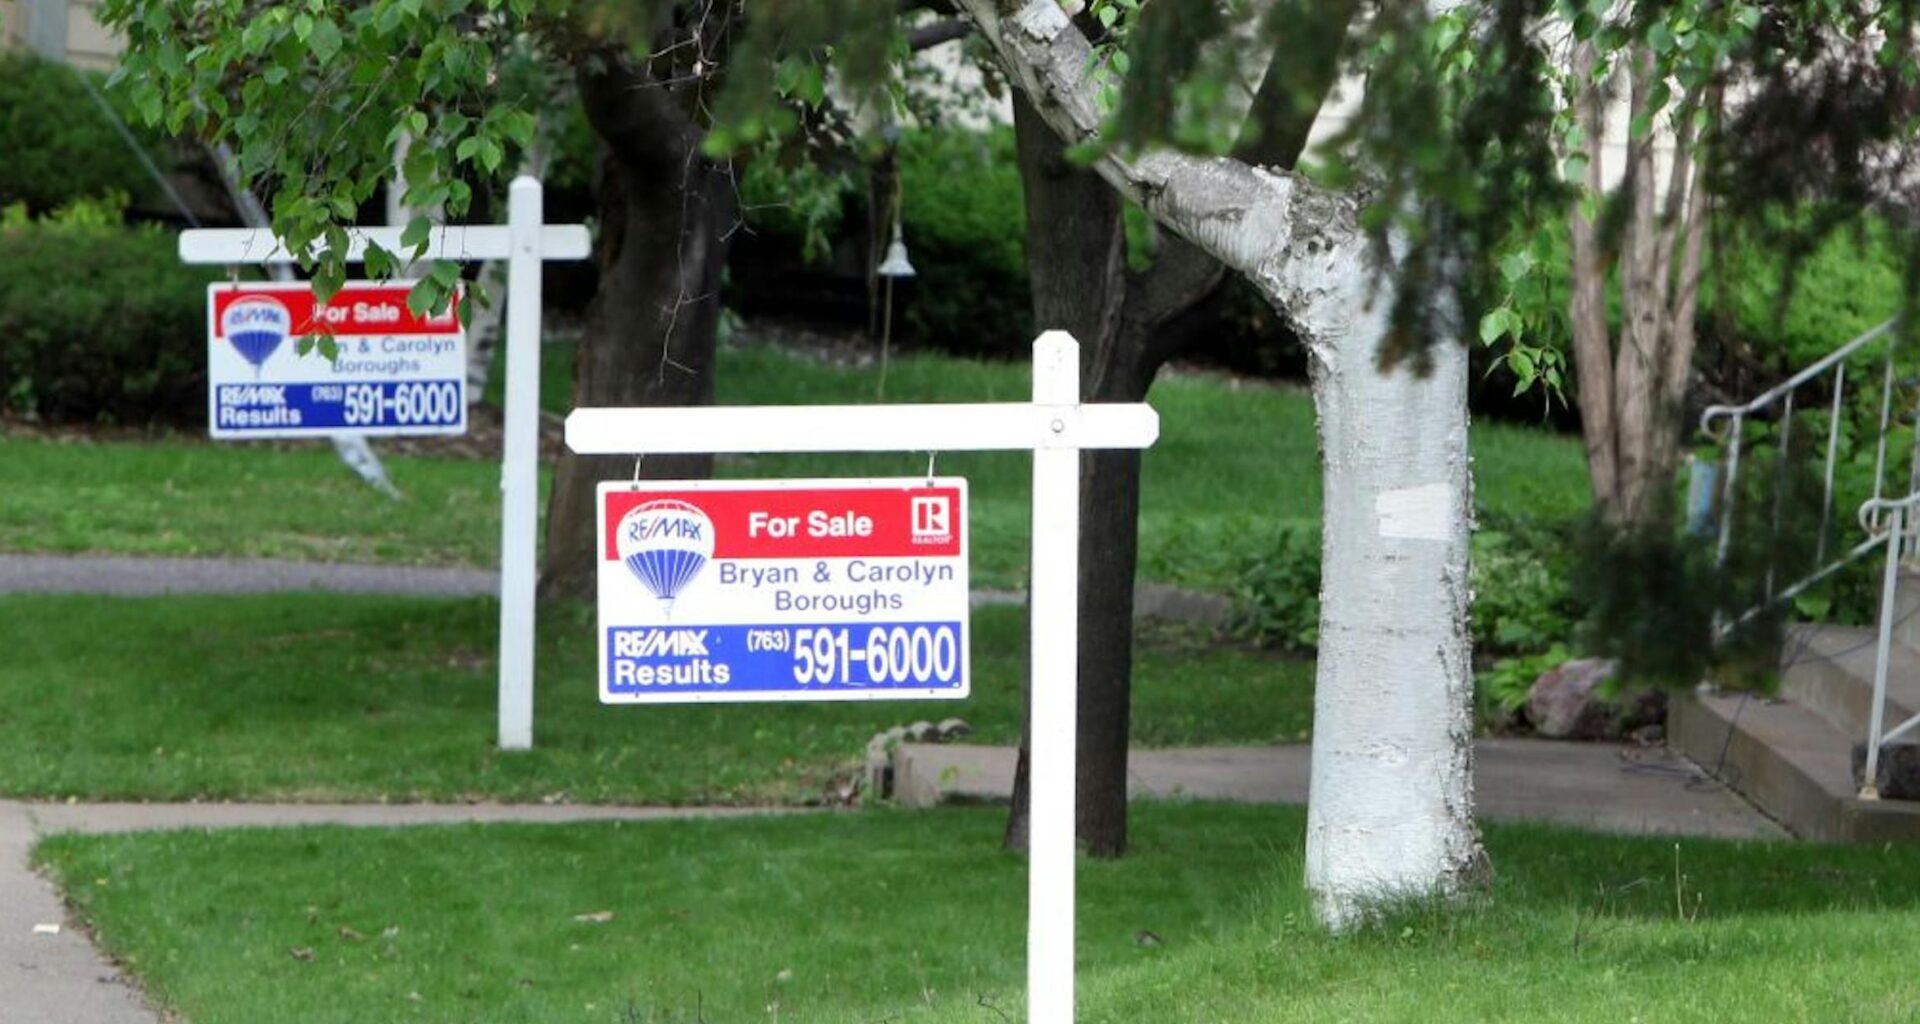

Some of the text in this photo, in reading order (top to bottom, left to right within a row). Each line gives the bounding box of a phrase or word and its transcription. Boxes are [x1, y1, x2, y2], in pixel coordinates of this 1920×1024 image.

[353, 302, 400, 322] Sale
[358, 338, 370, 353] &
[381, 336, 455, 355] Carolyn
[220, 406, 303, 426] Results
[344, 382, 458, 424] 591-6000
[628, 516, 703, 542] RE/MAX
[749, 510, 874, 538] For Sale
[720, 560, 954, 588] Bryan & Carolyn
[775, 590, 903, 615] Boroughs
[613, 629, 710, 658] RE/MAX
[747, 626, 957, 685] (763) 591-6000
[614, 659, 731, 686] Results
